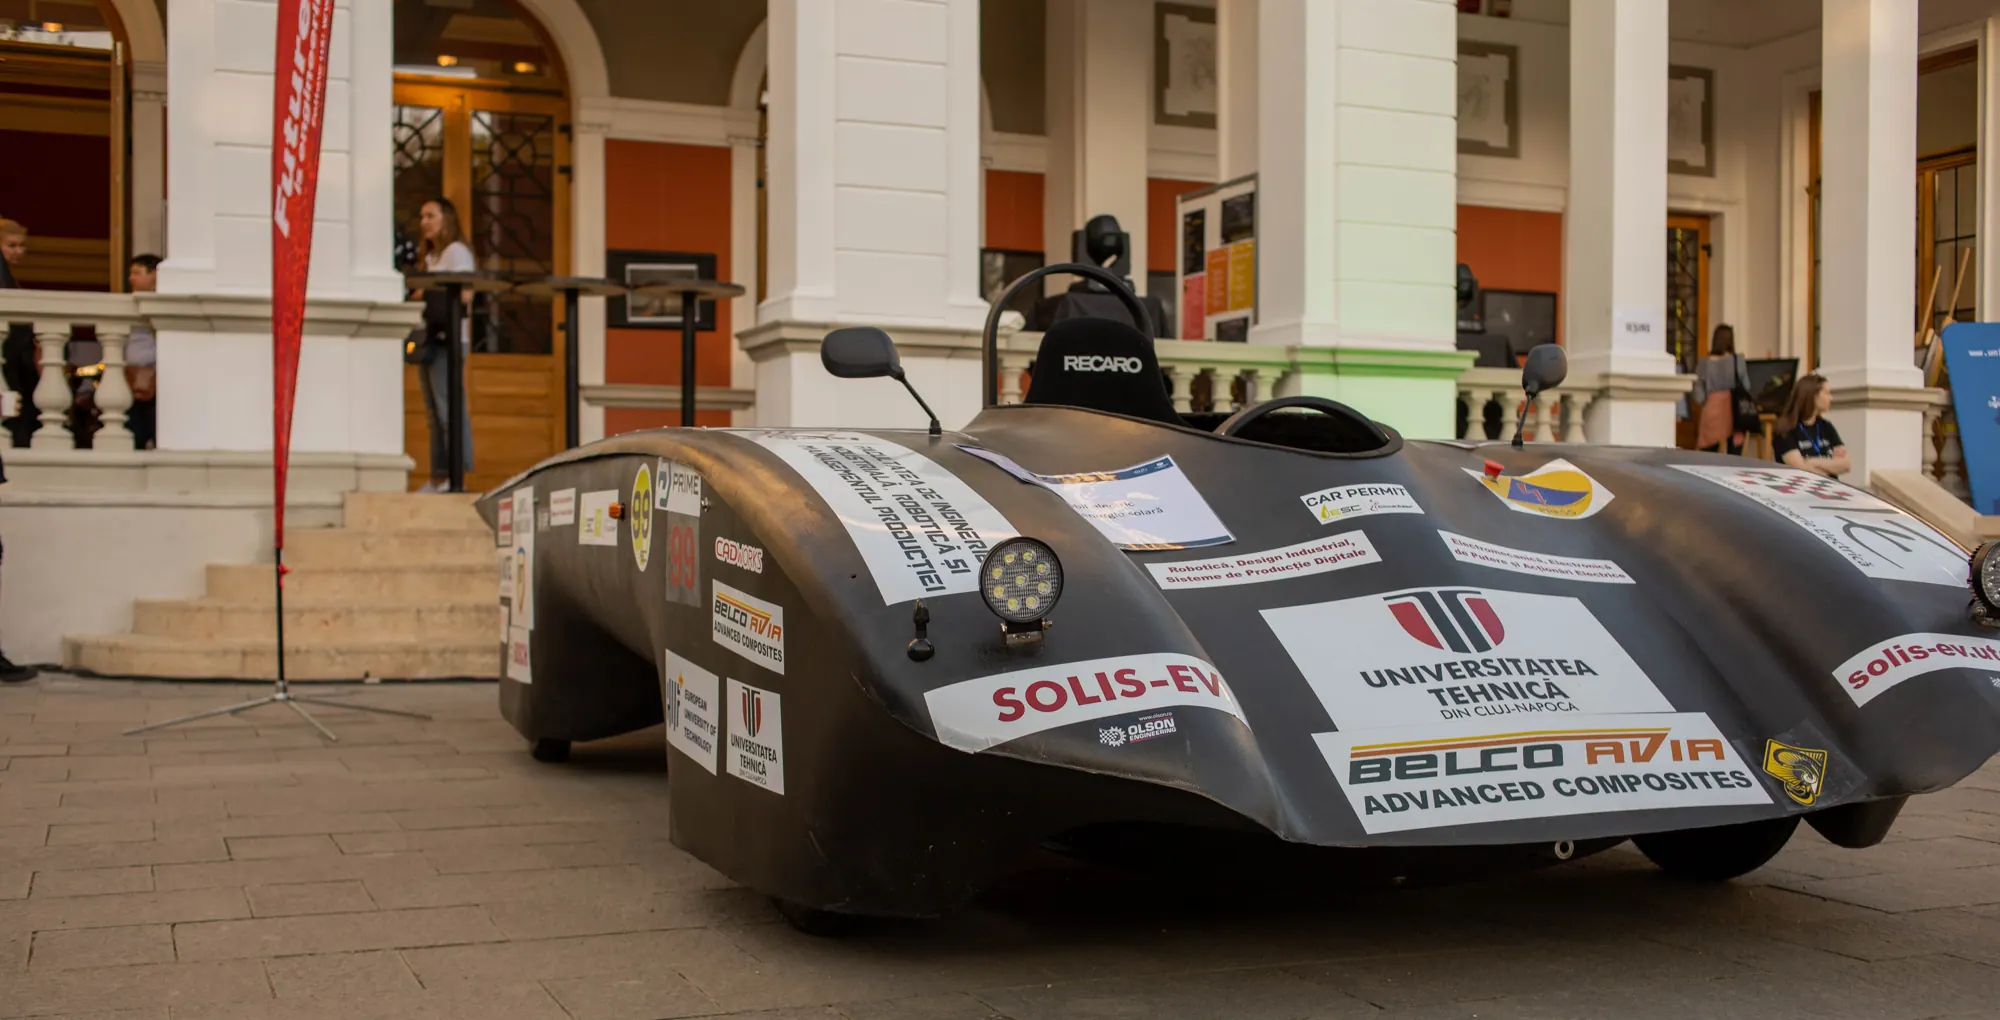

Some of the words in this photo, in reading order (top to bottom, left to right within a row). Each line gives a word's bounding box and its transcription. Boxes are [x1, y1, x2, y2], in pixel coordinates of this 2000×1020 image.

[1064, 355, 1142, 373] RECARO
[672, 473, 699, 495] PRIME
[915, 488, 943, 500] DE
[1306, 491, 1342, 507] CAR
[1346, 486, 1407, 498] PERMIT
[633, 489, 650, 539] 99
[670, 524, 696, 590] 99
[715, 537, 763, 573] CADWORKS
[872, 507, 946, 592] PRODUCȚIEI
[1168, 562, 1234, 573] Robotică,
[1236, 555, 1283, 567] Design
[1285, 539, 1356, 559] Industrial,
[1454, 548, 1469, 557] de
[1470, 551, 1508, 565] Putere
[1574, 568, 1626, 579] Electrice
[1166, 575, 1222, 583] Sisteme
[1245, 560, 1312, 577] Producție
[1313, 549, 1367, 565] Digitale
[714, 619, 741, 643] ADVANCED
[741, 635, 783, 662] COMPOSITES
[749, 614, 782, 642] AVIA
[1360, 657, 1599, 688] UNIVERSITATEA
[1848, 643, 2000, 689] solis-ev.ut
[684, 689, 707, 711] EUROPEAN
[992, 665, 1220, 722] SOLIS-EV
[1427, 679, 1571, 706] TEHNICĂ
[684, 708, 709, 732] UNIVERSITY
[709, 725, 717, 736] OF
[1138, 711, 1173, 721] www.olson.ro
[1440, 708, 1472, 720] DIN
[1474, 701, 1579, 717] CLUJ-NAPOCA
[684, 726, 712, 754] TECHNOLOGY
[1128, 718, 1175, 735] OLSON
[1129, 727, 1177, 741] ENGINEERING
[730, 733, 778, 763] UNIVERSITATEA
[1586, 736, 1725, 766] AVIA
[1365, 780, 1546, 815] ADVANCED
[1552, 770, 1753, 798] COMPOSITES
